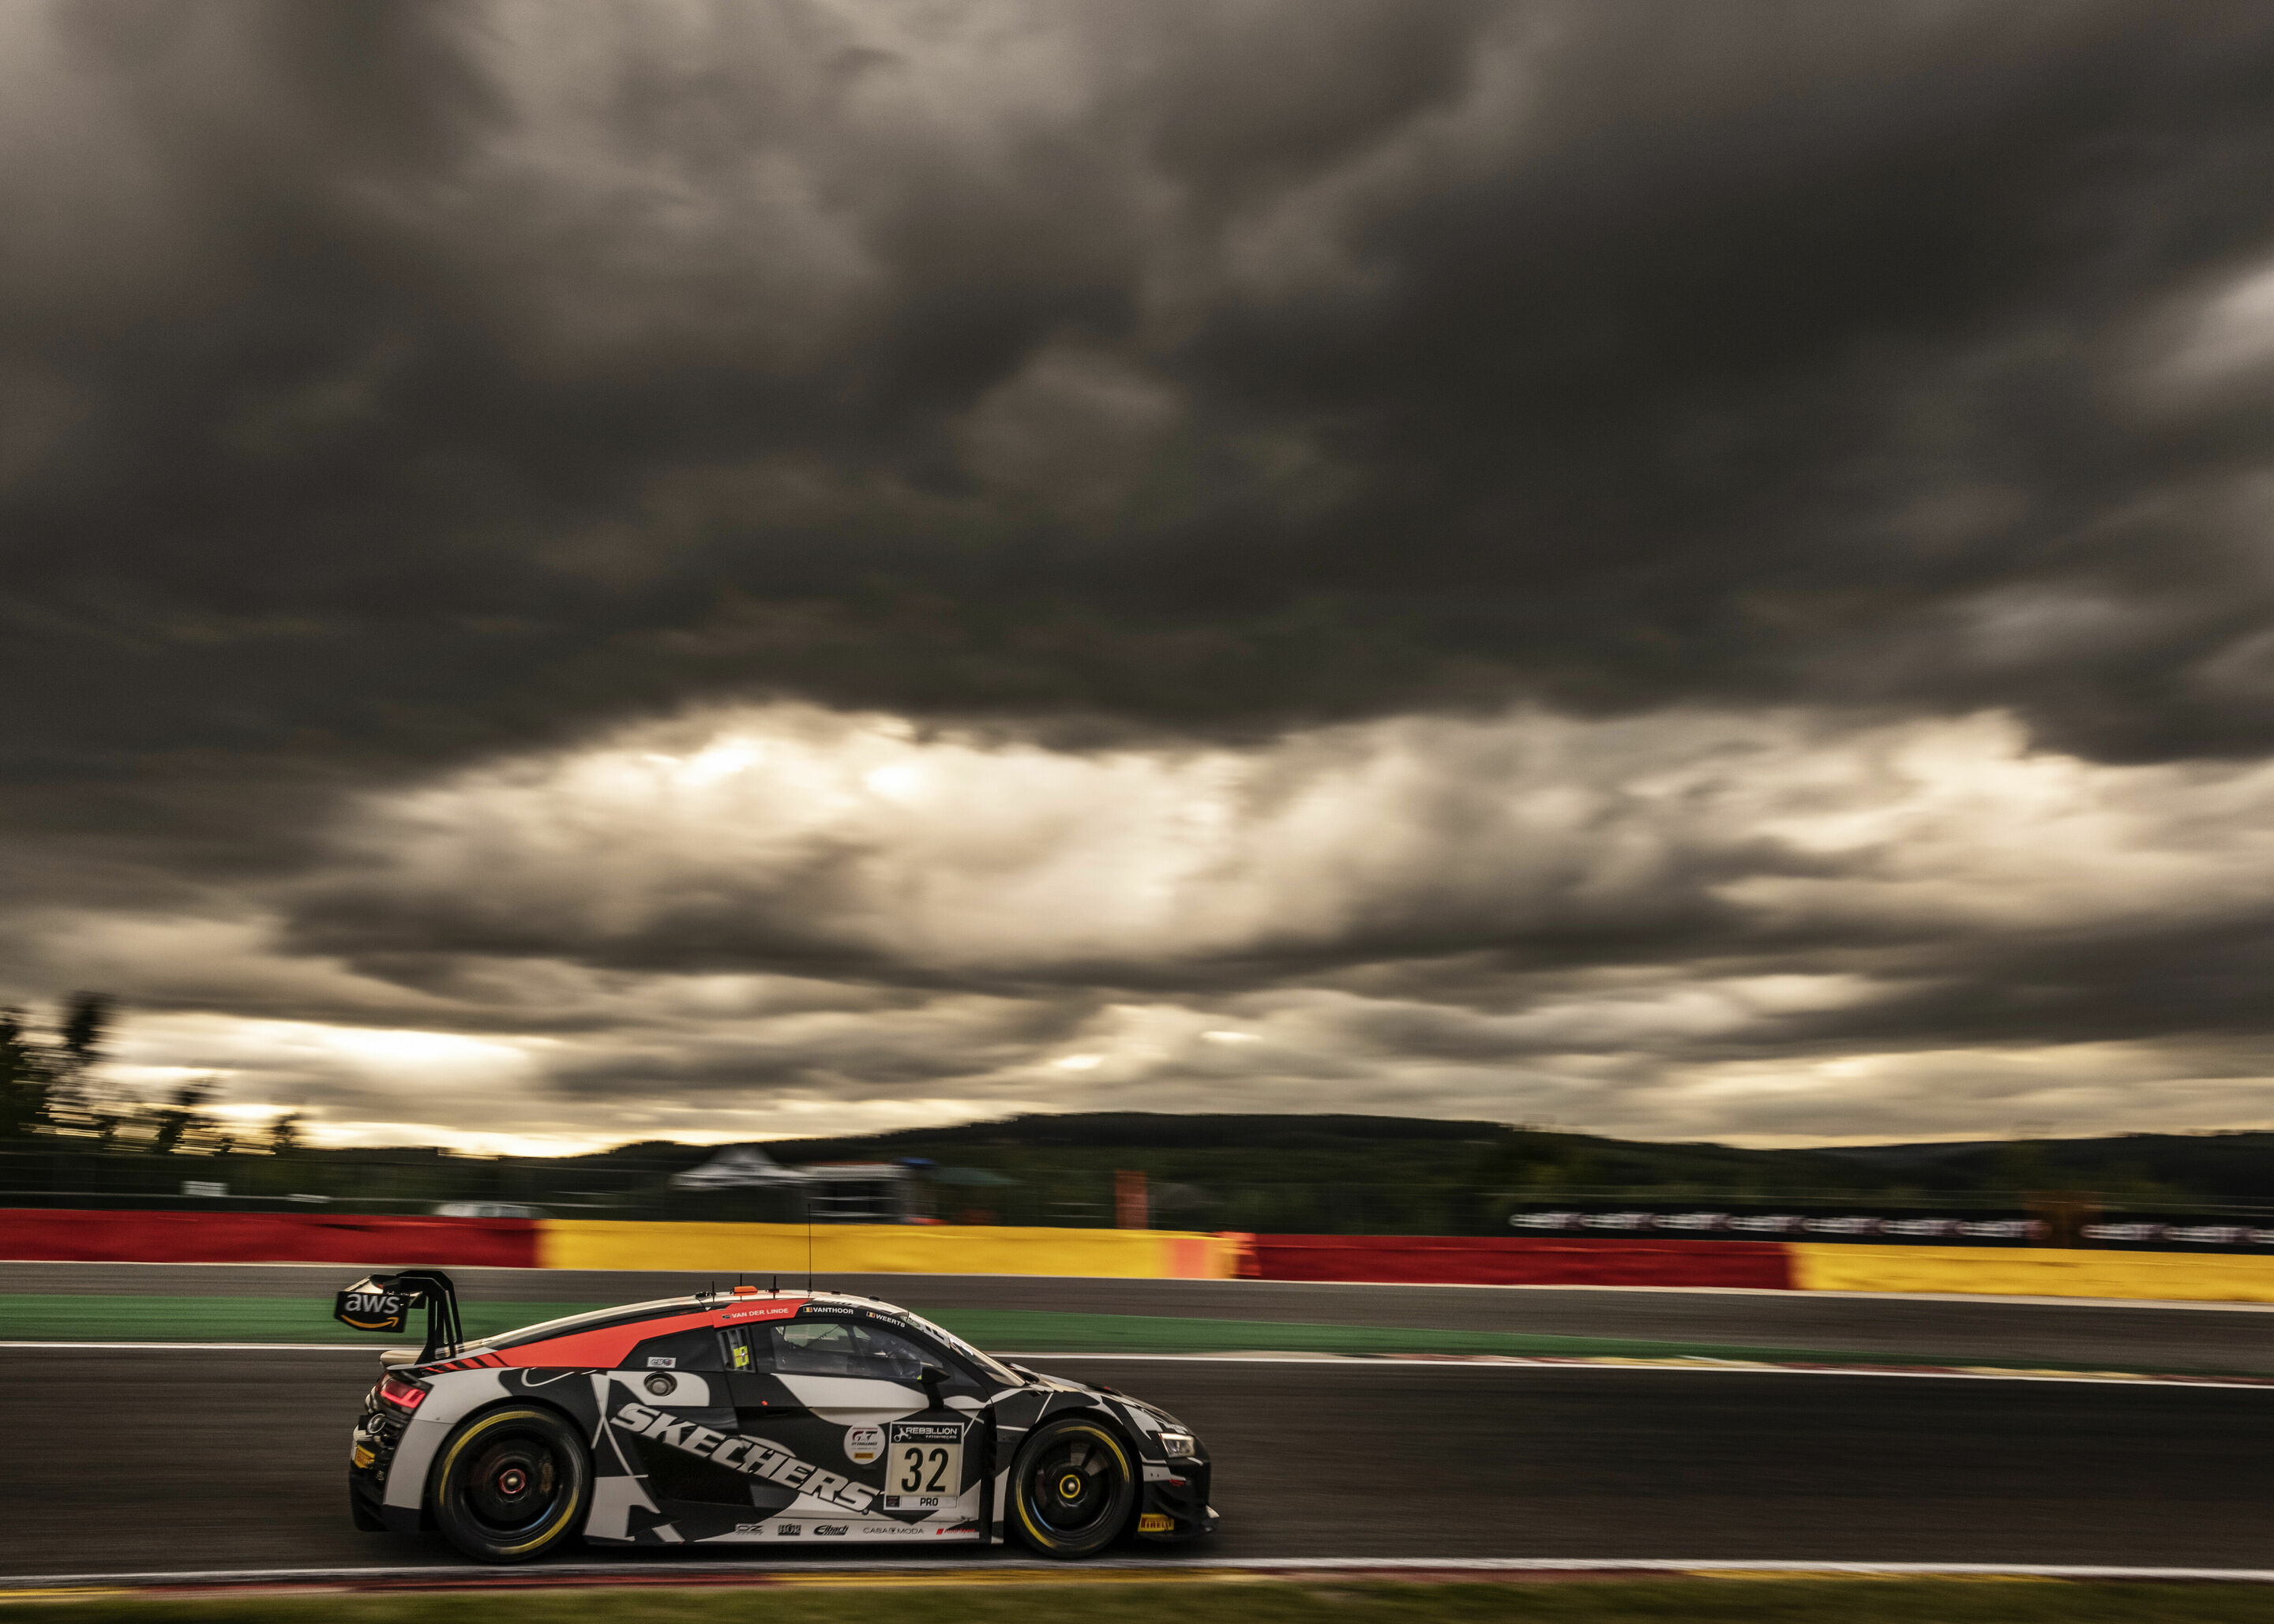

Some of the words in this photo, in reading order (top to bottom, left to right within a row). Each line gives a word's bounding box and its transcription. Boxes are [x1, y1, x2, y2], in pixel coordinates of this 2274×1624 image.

[345, 1294, 400, 1314] aws
[876, 1314, 906, 1328] WEERTS
[906, 1427, 957, 1435] REBELLION
[610, 1402, 881, 1513] SKECHERS
[901, 1446, 948, 1493] 32
[919, 1497, 939, 1506] PRO
